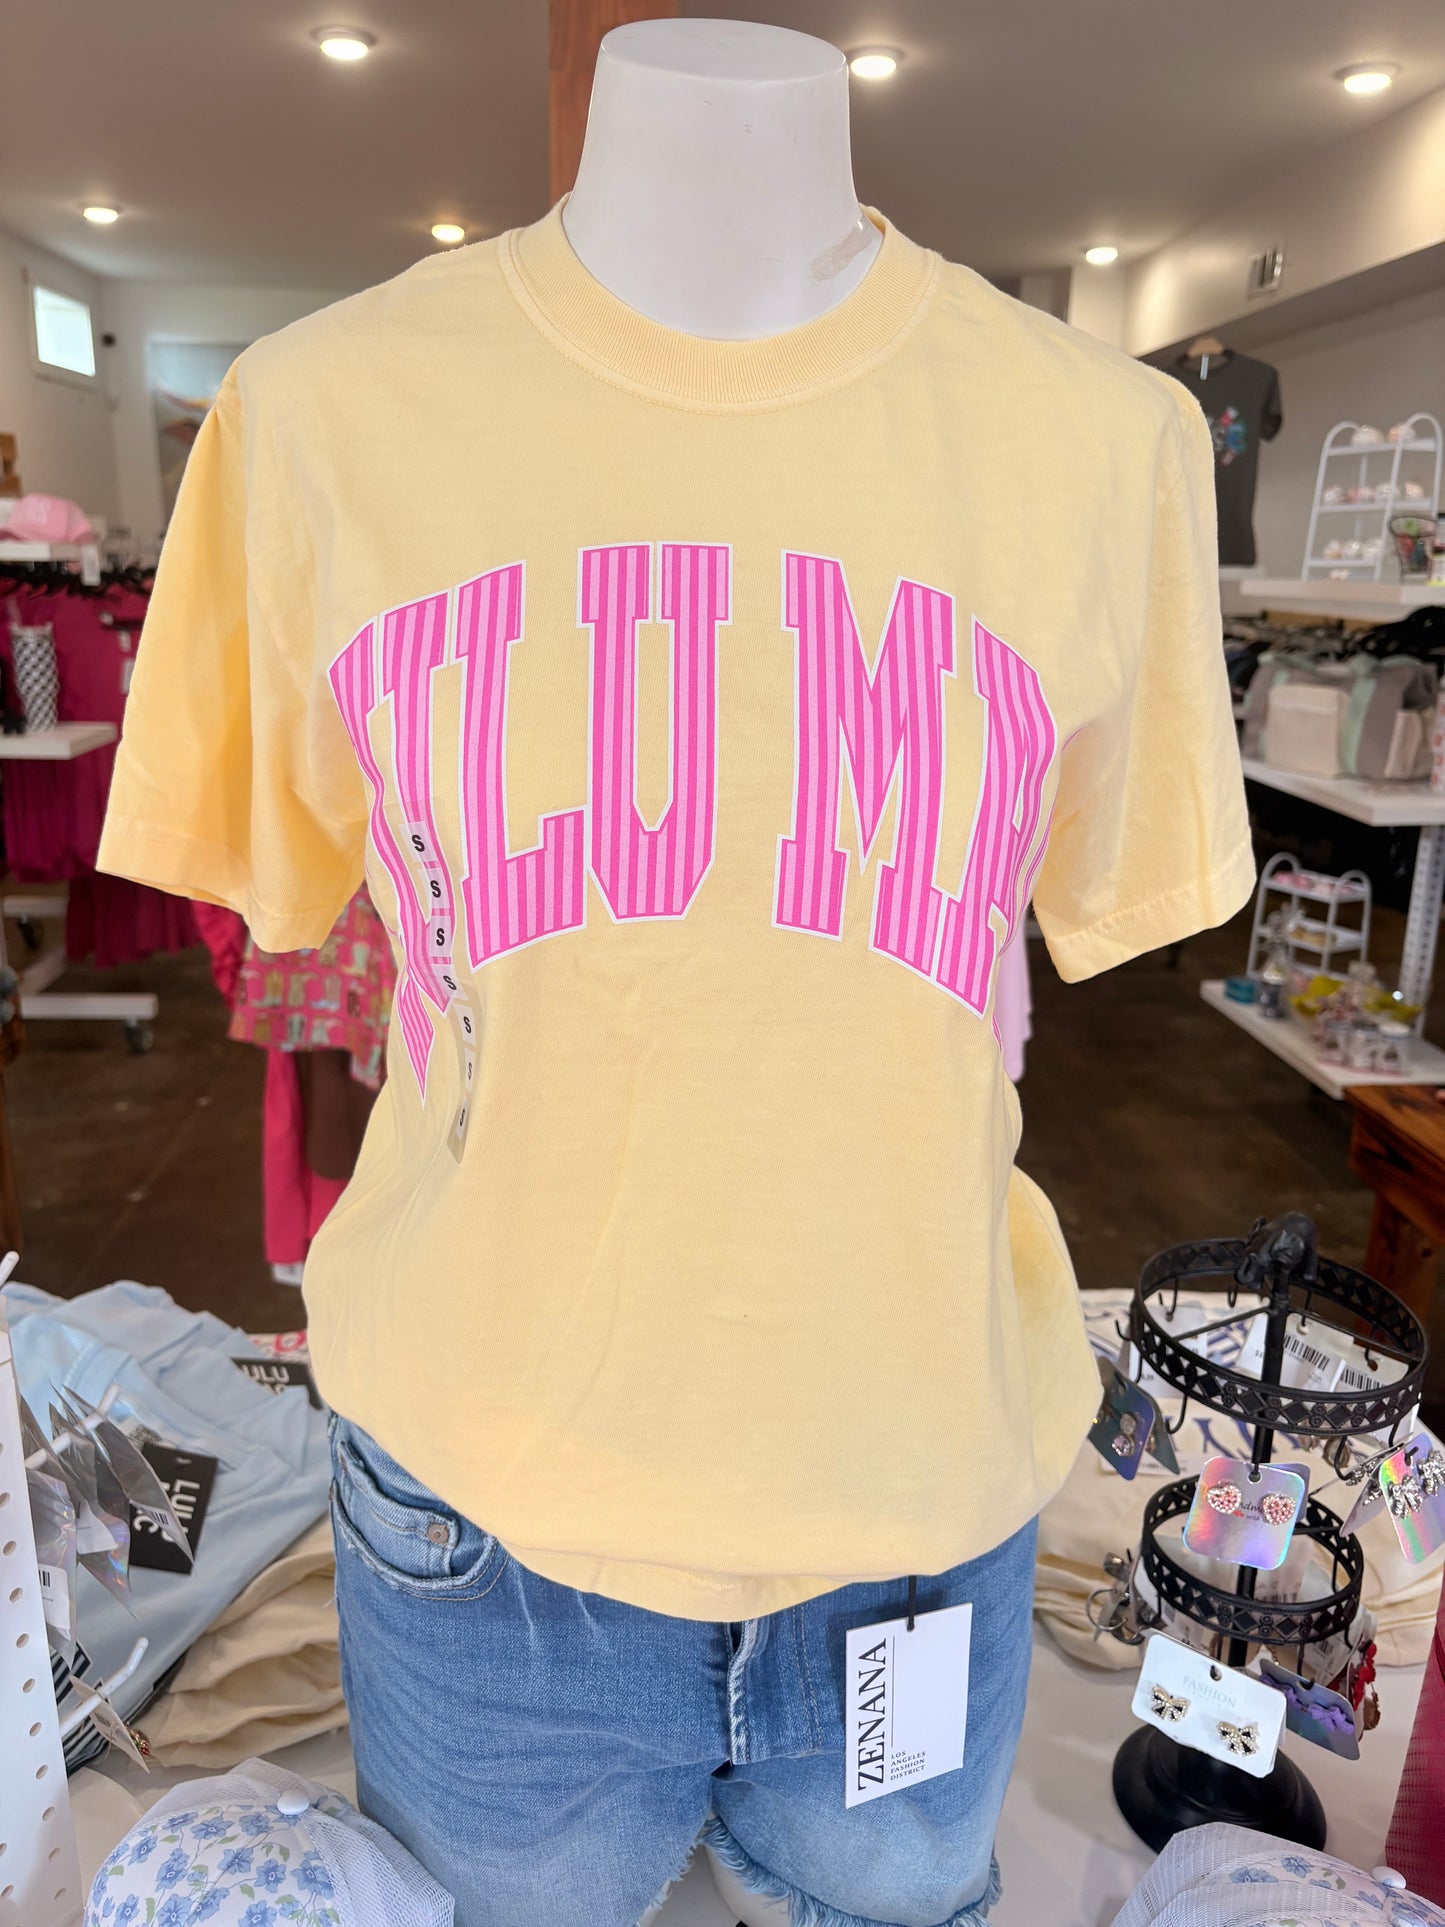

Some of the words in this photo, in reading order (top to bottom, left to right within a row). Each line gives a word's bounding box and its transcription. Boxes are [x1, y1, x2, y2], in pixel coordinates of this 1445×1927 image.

[411, 834, 426, 853] S
[430, 879, 442, 899] S
[435, 927, 446, 947] S
[443, 974, 457, 991] S
[463, 1015, 472, 1034] S
[466, 1060, 473, 1081] S
[240, 1364, 290, 1384] ULU
[1183, 1674, 1237, 1708] FASHION
[857, 1637, 887, 1791] ZENANA
[890, 1751, 926, 1767] ANGELES
[891, 1750, 906, 1760] LOS
[890, 1758, 925, 1774] FASHION
[890, 1764, 926, 1781] DISTRICT
